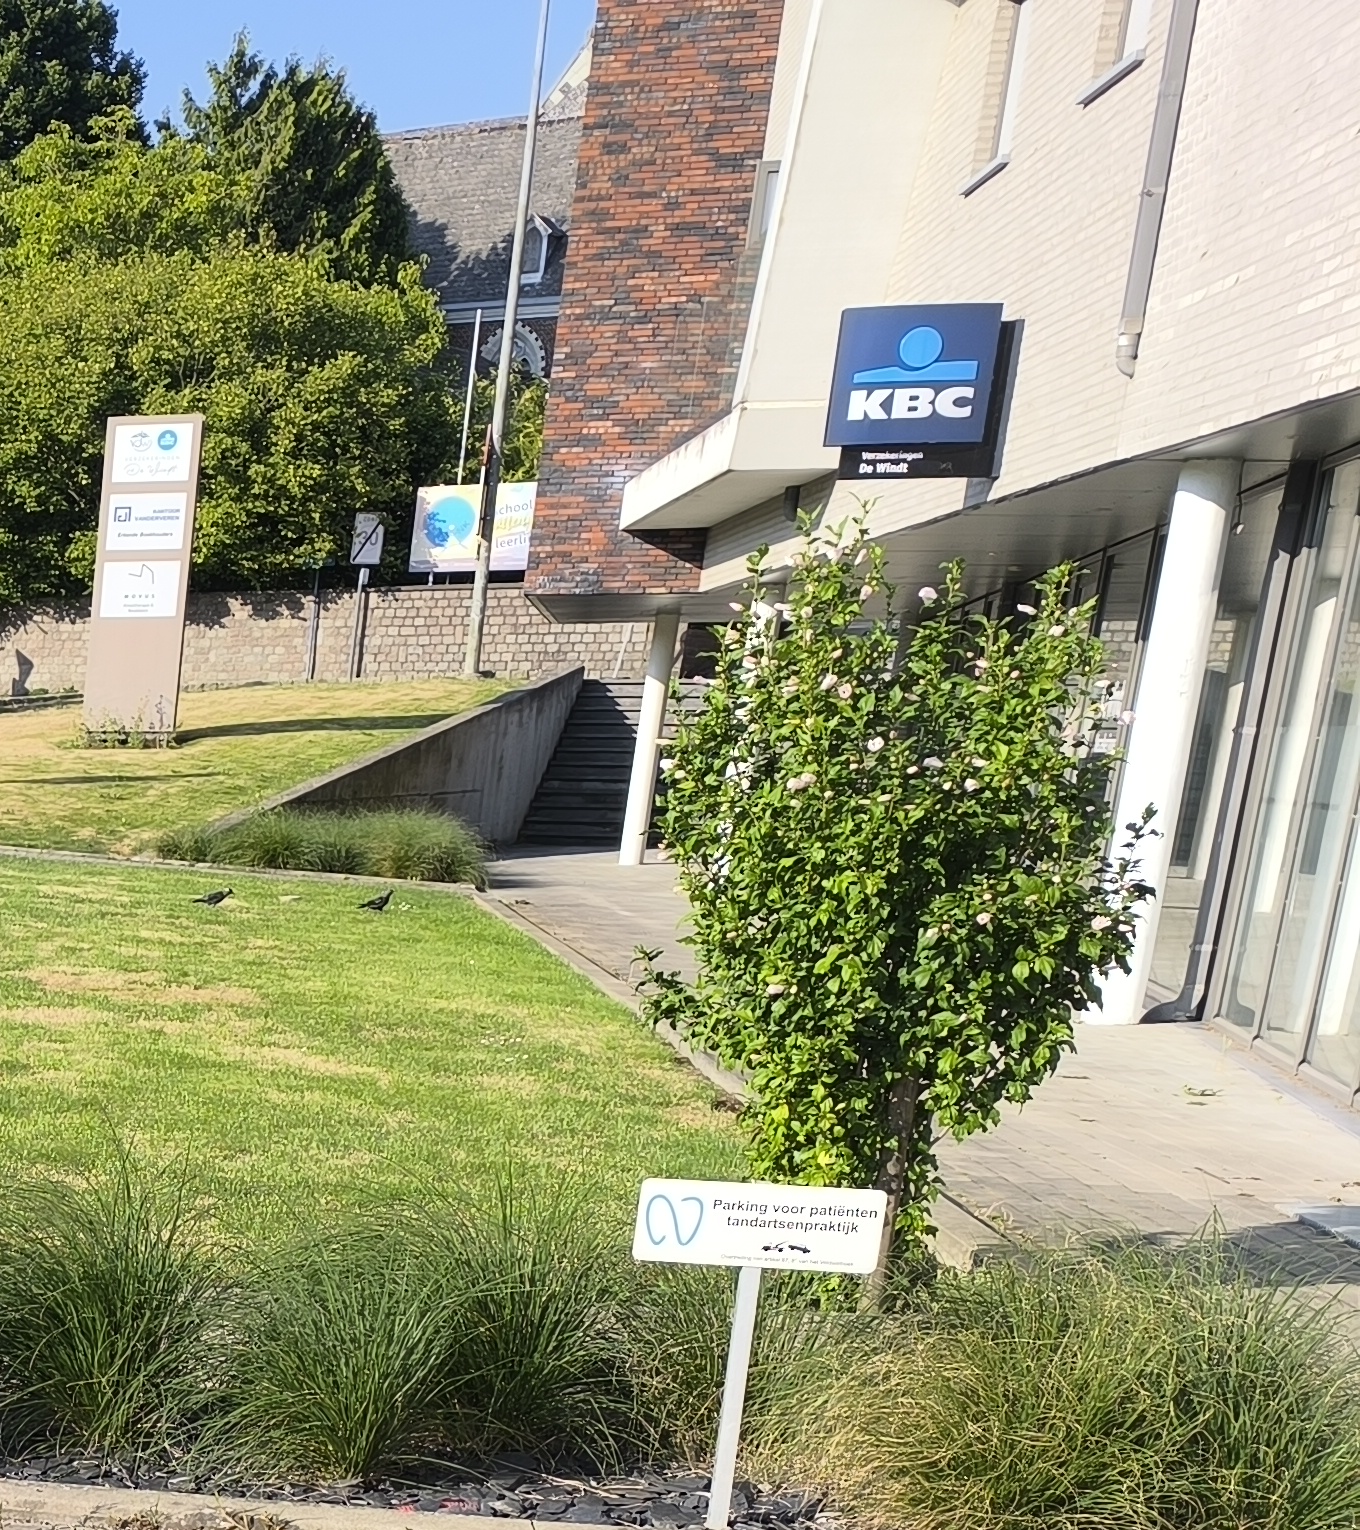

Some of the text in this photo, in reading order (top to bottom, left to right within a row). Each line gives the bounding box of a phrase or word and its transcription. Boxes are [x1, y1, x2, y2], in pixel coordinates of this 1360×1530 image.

[846, 386, 975, 421] KBC
[859, 462, 909, 473] De Windt
[495, 499, 533, 515] chool
[713, 1199, 878, 1219] Parking voor patiënten
[727, 1216, 859, 1234] tandartsenpraktijk
